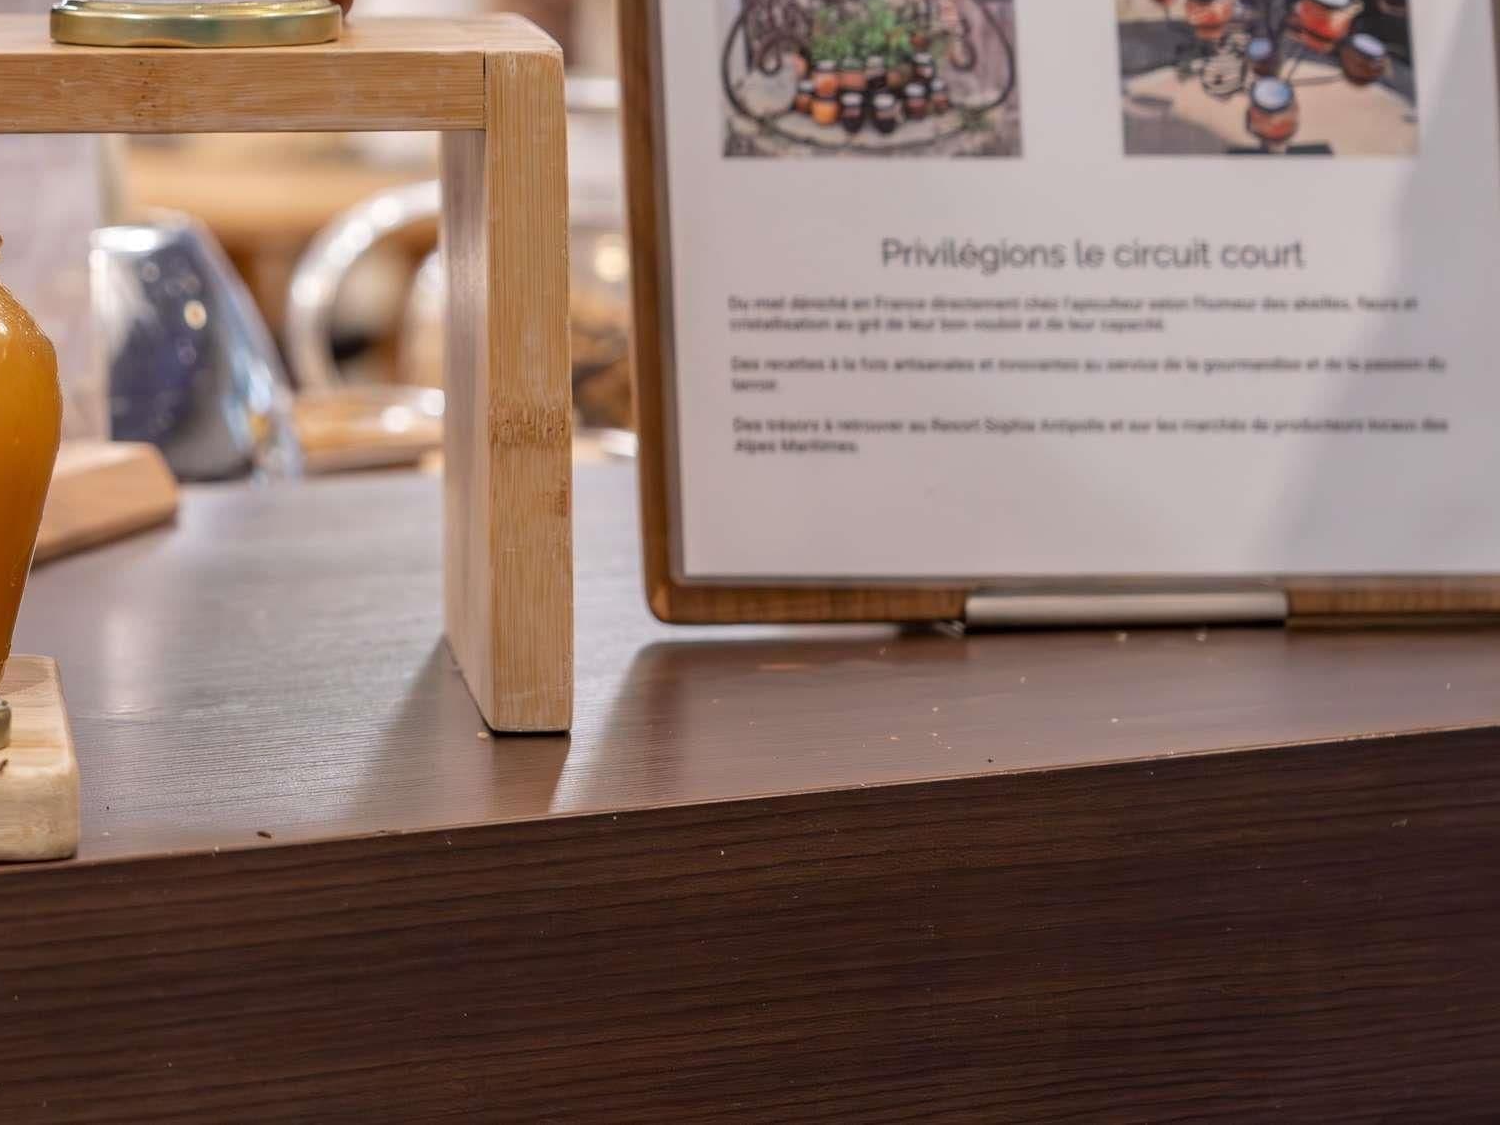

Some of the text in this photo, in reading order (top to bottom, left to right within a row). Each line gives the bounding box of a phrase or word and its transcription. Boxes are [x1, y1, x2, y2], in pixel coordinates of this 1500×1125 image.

[881, 236, 1306, 274] Privilégions le circuit court
